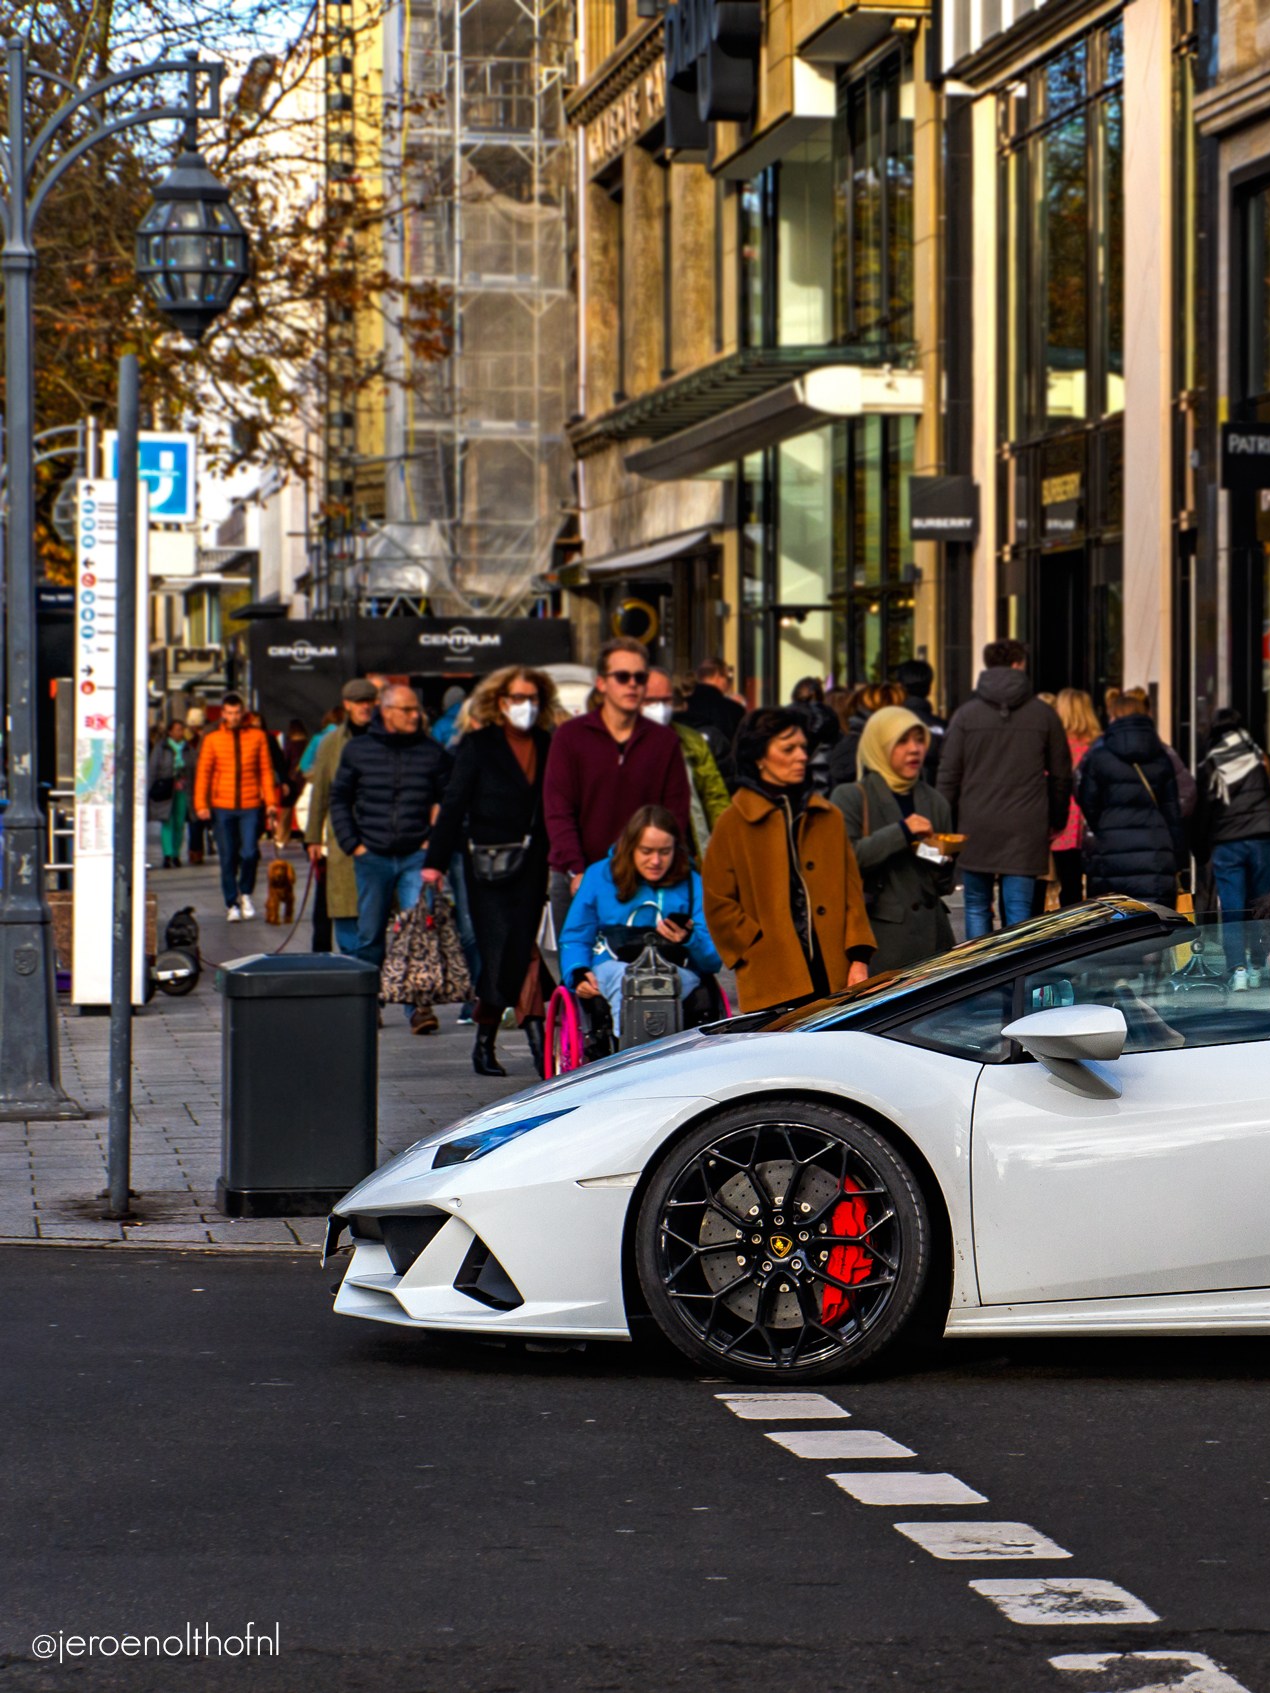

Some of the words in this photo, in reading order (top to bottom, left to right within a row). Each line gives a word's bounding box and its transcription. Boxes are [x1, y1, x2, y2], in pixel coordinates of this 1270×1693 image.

[912, 517, 973, 530] BURBERRY
[419, 634, 501, 646] CENTRUM
[267, 646, 337, 657] CENTRUM
